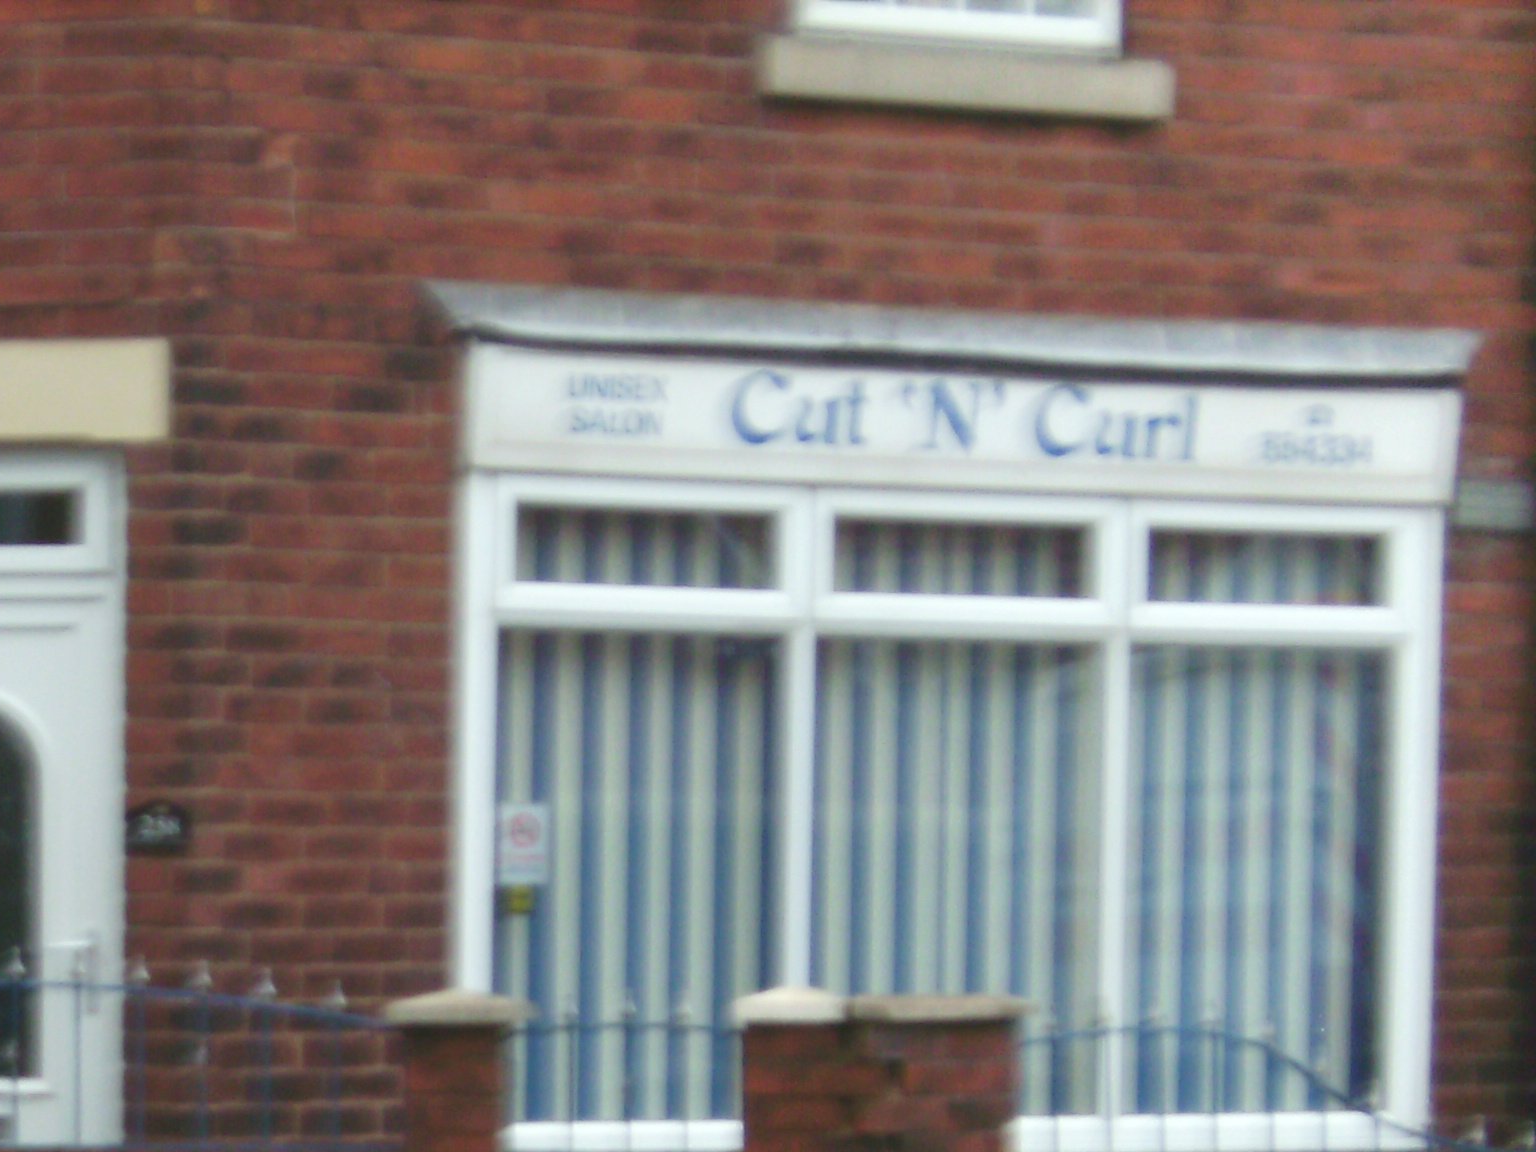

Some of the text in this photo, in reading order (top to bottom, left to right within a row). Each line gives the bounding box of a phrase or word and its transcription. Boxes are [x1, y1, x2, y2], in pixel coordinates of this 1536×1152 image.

[569, 373, 668, 401] UNISEX
[570, 406, 662, 434] SALON
[731, 368, 866, 444] Cut
[1036, 383, 1200, 460] Curl
